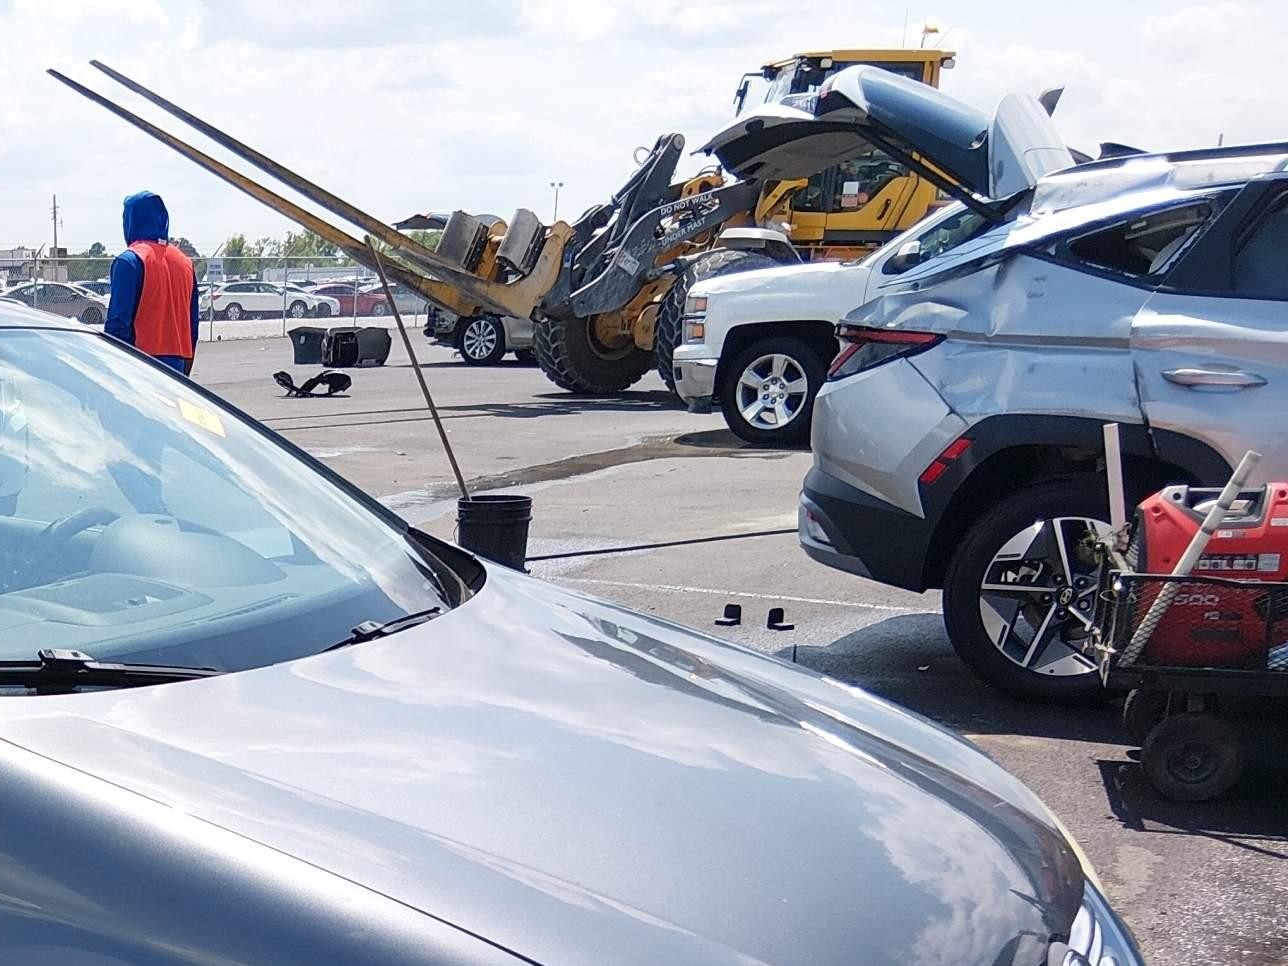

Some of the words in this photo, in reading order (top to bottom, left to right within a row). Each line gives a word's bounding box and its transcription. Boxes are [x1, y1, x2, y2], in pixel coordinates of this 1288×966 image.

[660, 207, 672, 216] DO
[674, 200, 690, 212] NOT
[692, 193, 713, 205] WALK
[661, 228, 686, 246] UNDER
[687, 217, 706, 231] MAST
[1173, 594, 1220, 606] 500
